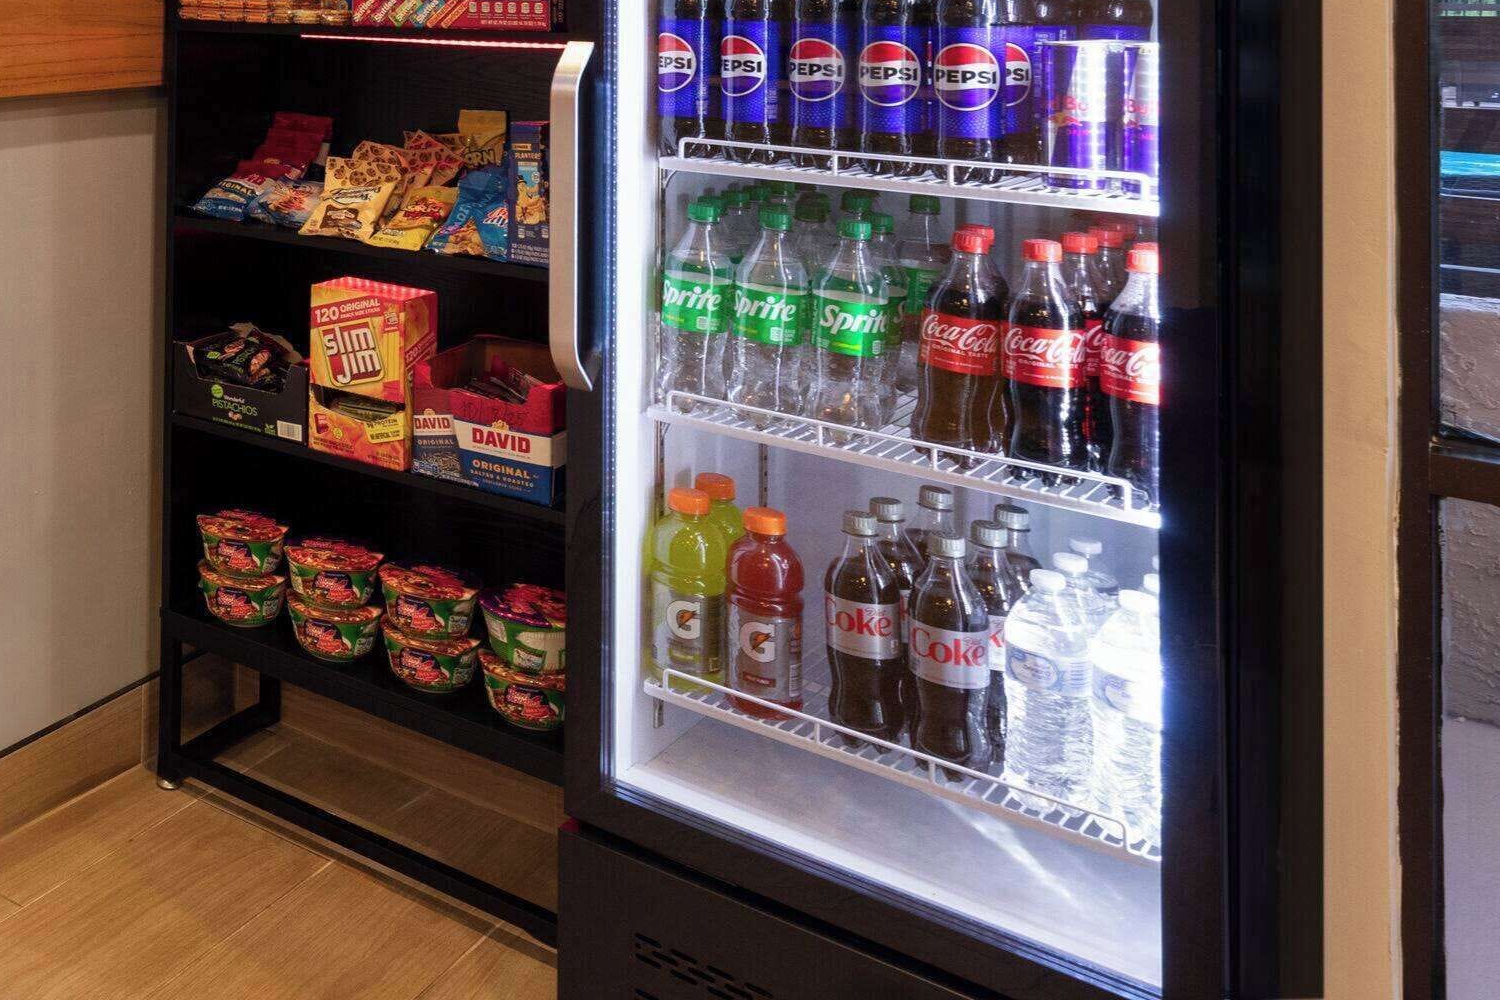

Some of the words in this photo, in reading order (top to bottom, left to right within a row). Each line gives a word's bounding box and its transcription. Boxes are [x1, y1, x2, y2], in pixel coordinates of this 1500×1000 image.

[659, 55, 692, 70] EPSI
[723, 58, 763, 73] EPSI
[860, 65, 918, 81] PEPSI
[934, 69, 997, 84] PEPSI
[221, 181, 253, 196] IGINAL
[315, 306, 340, 324] 120
[339, 298, 381, 312] ORIGINAL
[212, 398, 258, 417] PISTACHIOS
[414, 417, 451, 430] DAVID
[472, 427, 531, 454] DAVID
[472, 459, 531, 480] ORIGINAL
[470, 469, 494, 479] SALTED
[502, 476, 534, 488] ROASTED
[910, 627, 985, 667] Coke
